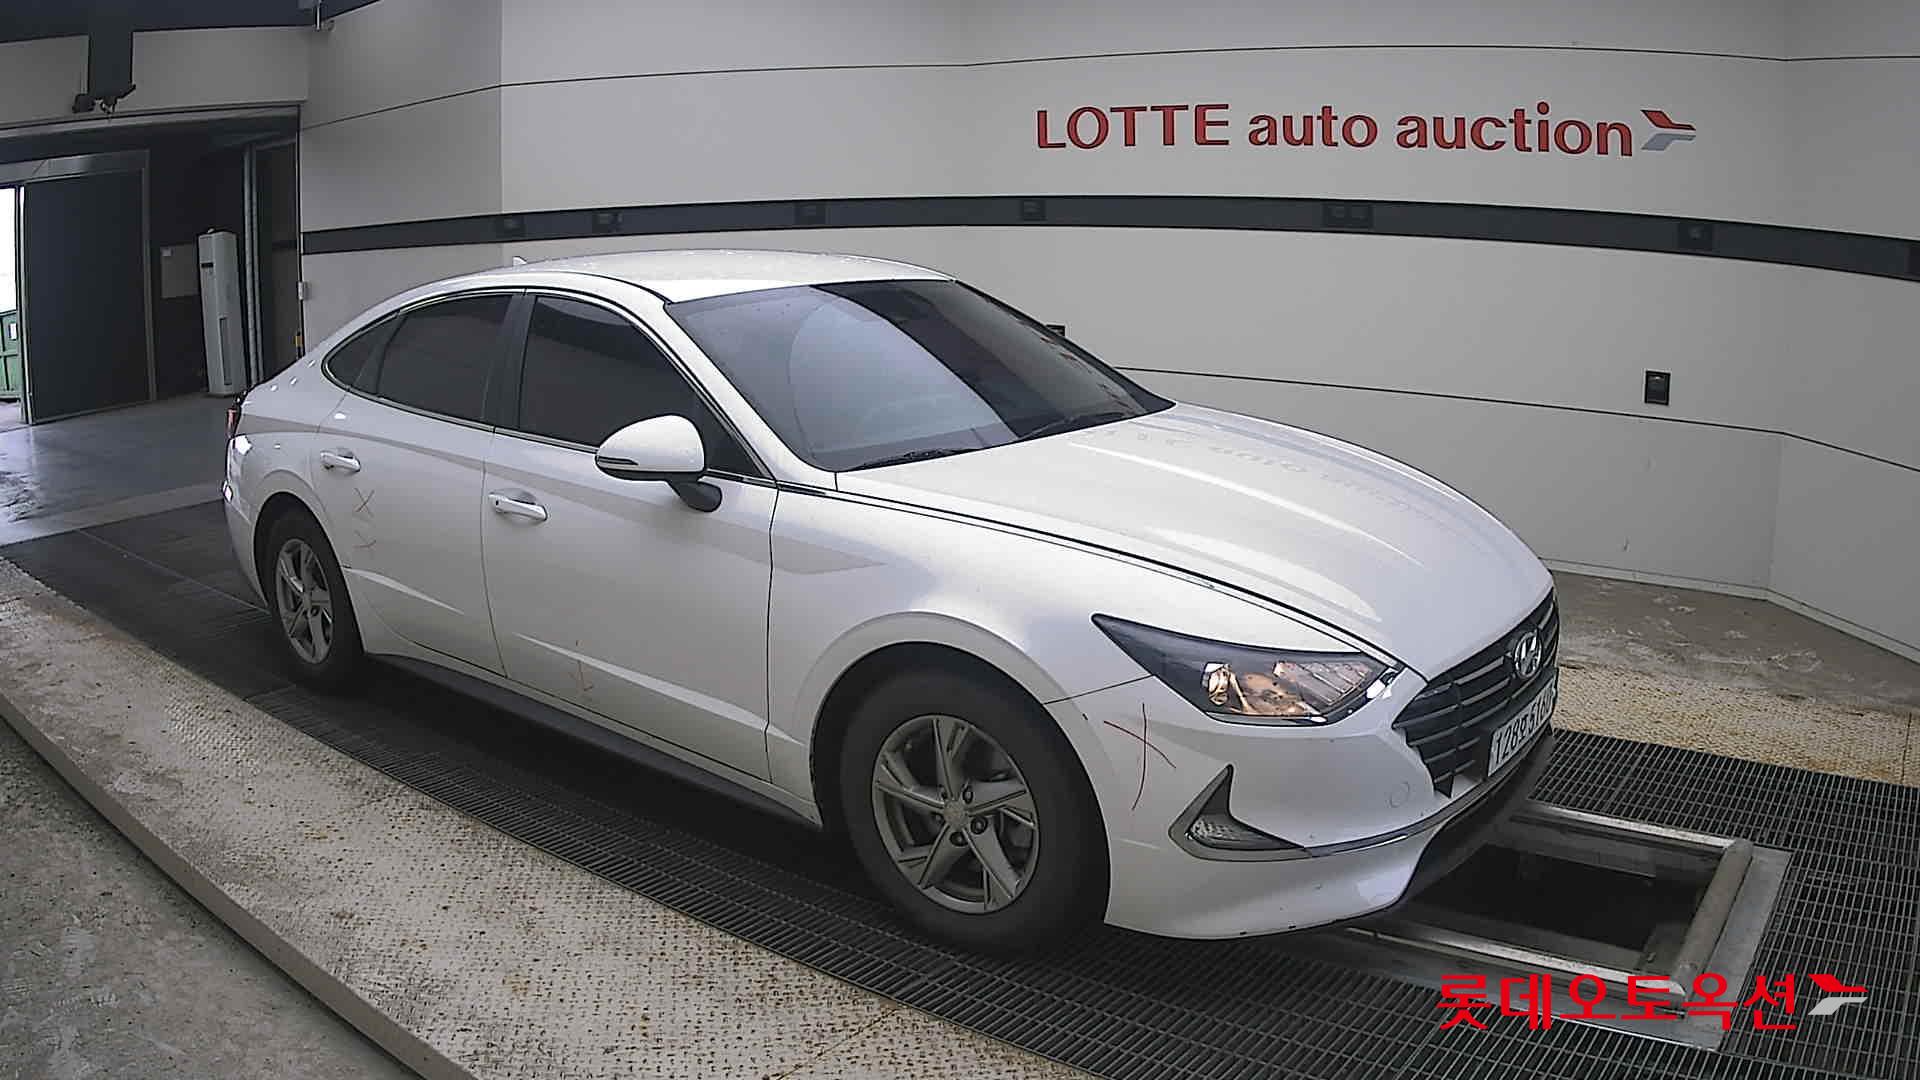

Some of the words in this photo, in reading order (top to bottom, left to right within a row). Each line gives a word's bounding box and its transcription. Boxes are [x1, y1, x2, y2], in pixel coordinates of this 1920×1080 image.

[1037, 103, 1230, 149] LOTTE
[1248, 105, 1378, 148] auto
[1396, 102, 1633, 155] auction
